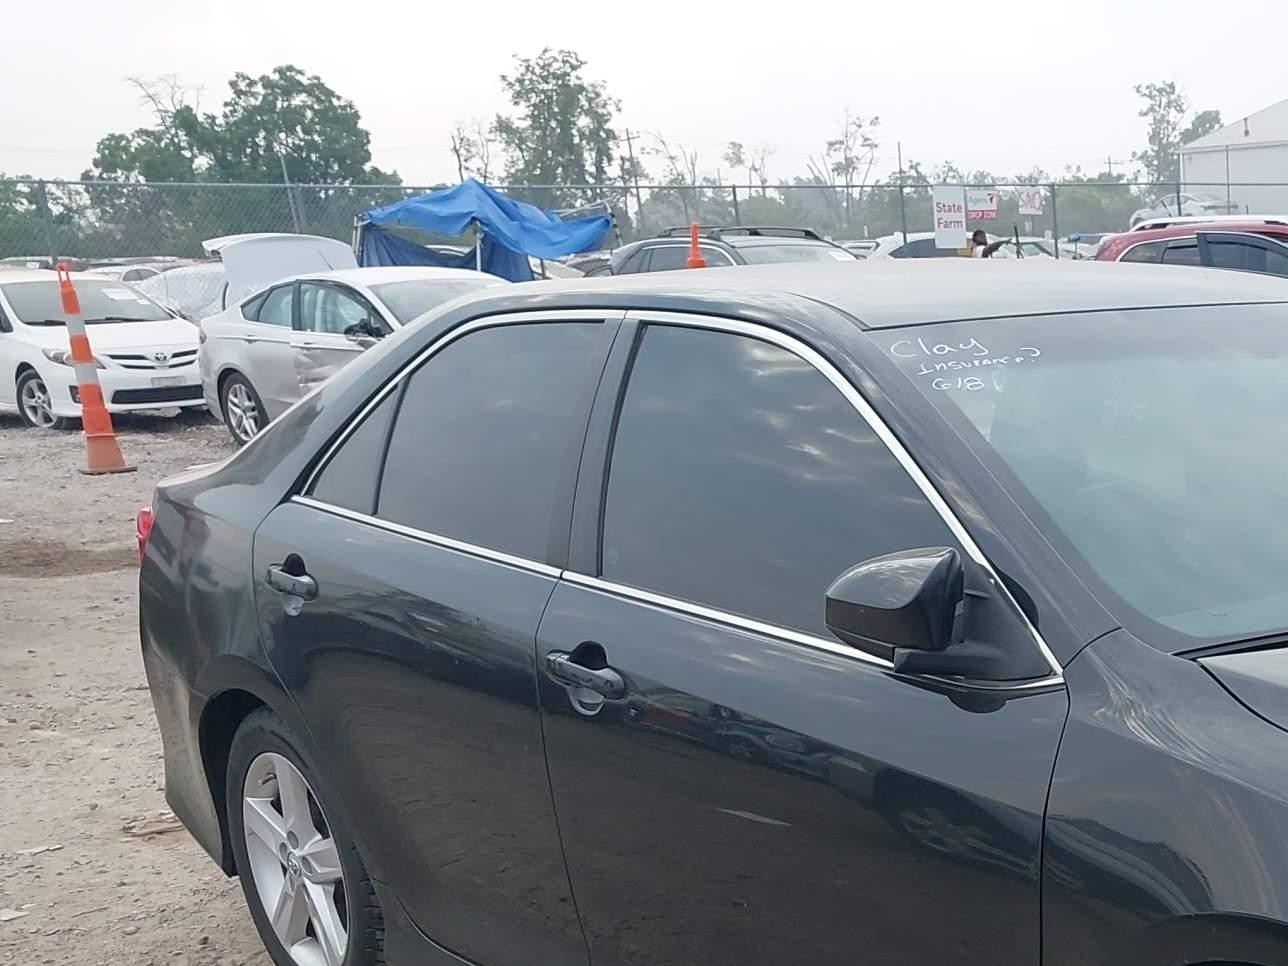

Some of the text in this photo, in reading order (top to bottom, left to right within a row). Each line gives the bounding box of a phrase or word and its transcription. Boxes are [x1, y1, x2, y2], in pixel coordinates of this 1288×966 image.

[936, 202, 963, 214] State
[937, 218, 963, 229] Farm
[890, 337, 989, 358] Clay
